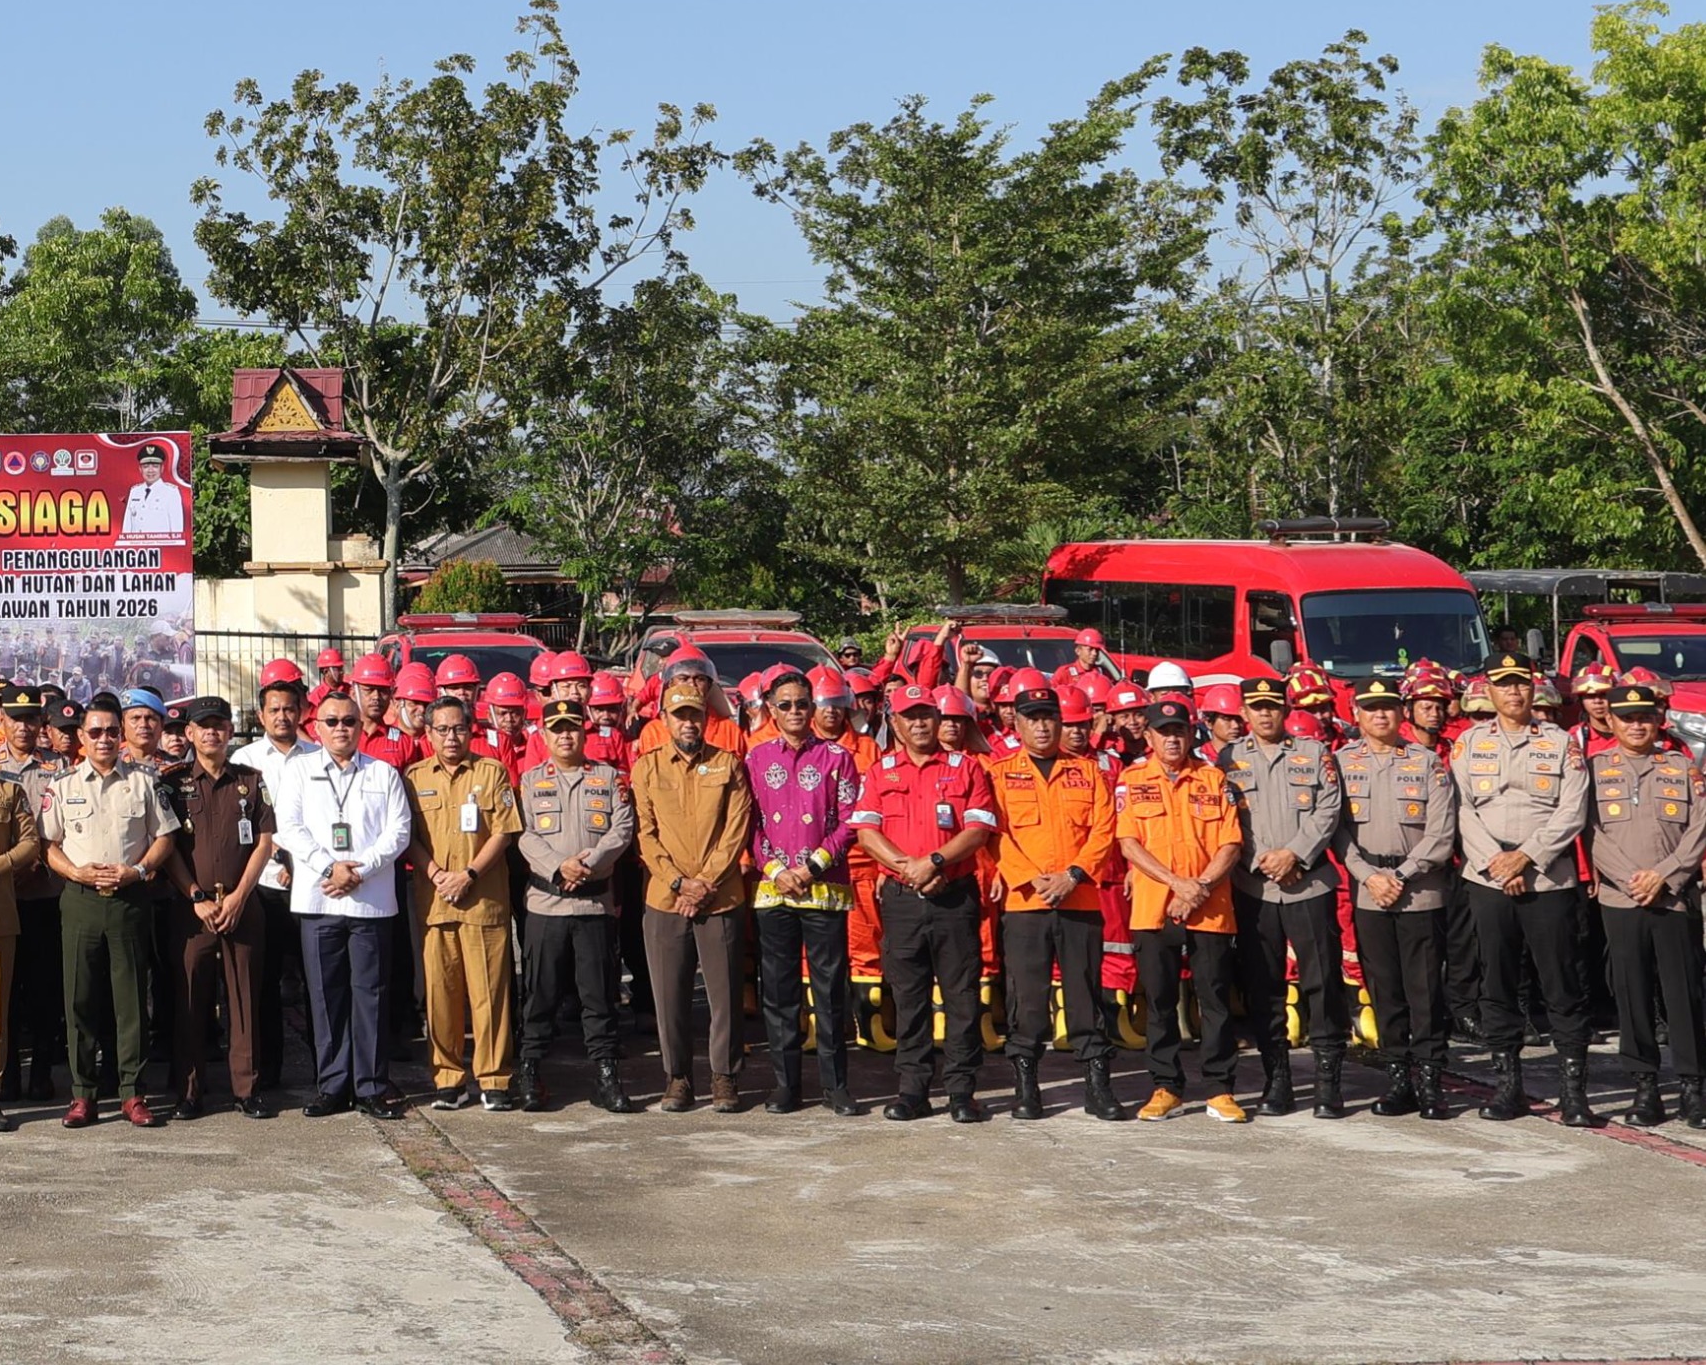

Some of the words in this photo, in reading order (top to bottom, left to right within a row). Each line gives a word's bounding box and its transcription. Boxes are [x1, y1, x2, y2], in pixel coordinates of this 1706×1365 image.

[3, 549, 160, 569] PENANGGULANGAN
[22, 574, 75, 594] HUTAN
[82, 574, 115, 593] DAN
[122, 573, 176, 592] LAHAN
[56, 599, 110, 618] TAHUN
[116, 598, 158, 617] 2026
[1529, 752, 1559, 760] POLRI
[1397, 775, 1425, 783] POLRI
[1656, 776, 1685, 785] POLRI
[584, 788, 610, 796] POLRI
